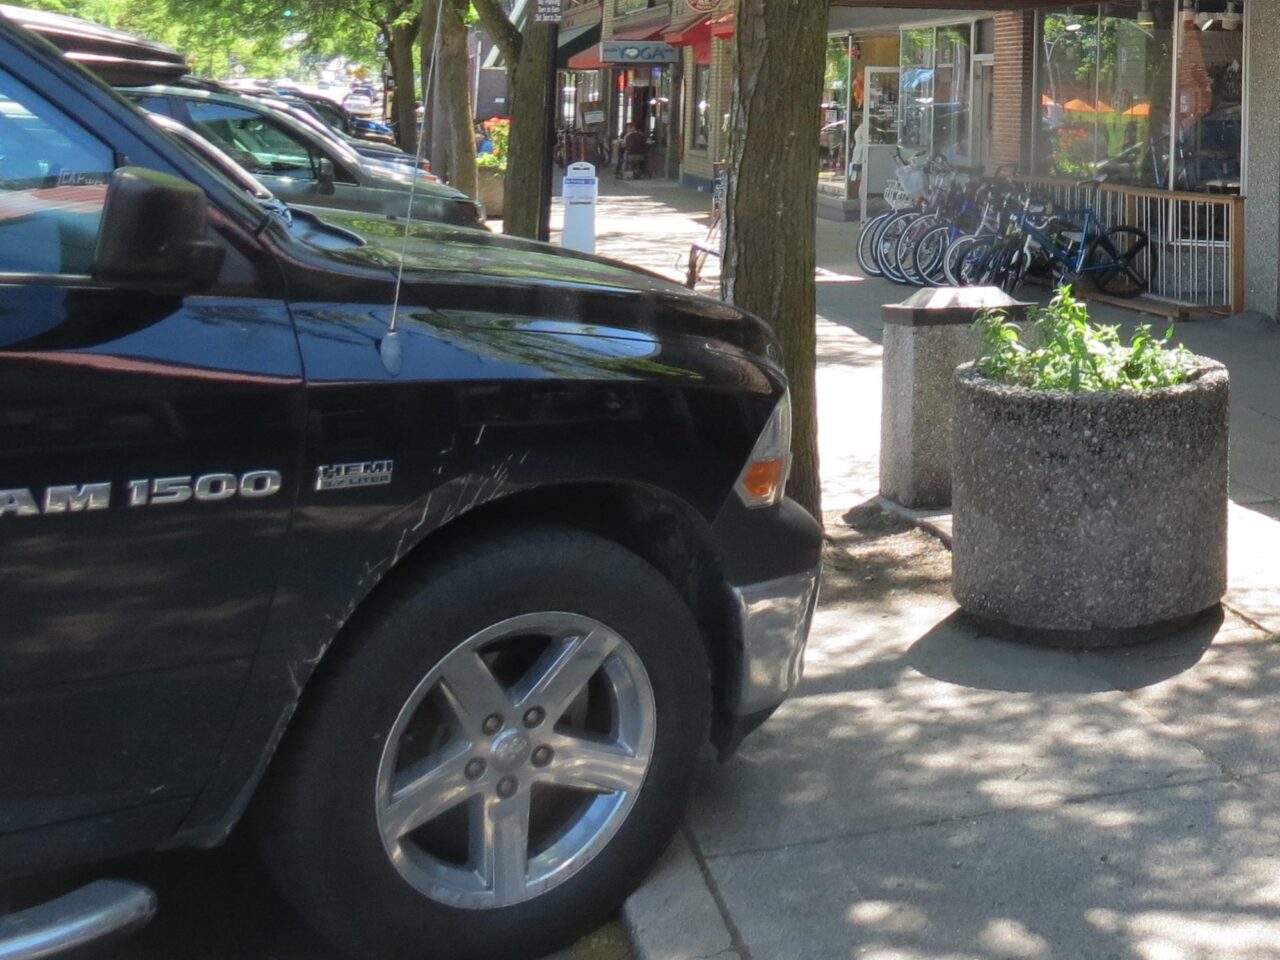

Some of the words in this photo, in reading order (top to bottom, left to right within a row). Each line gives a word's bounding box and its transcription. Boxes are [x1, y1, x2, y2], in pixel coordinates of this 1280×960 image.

[618, 46, 666, 60] YOGA
[321, 459, 393, 478] HEMI
[0, 481, 112, 516] AM
[127, 470, 283, 507] 1500
